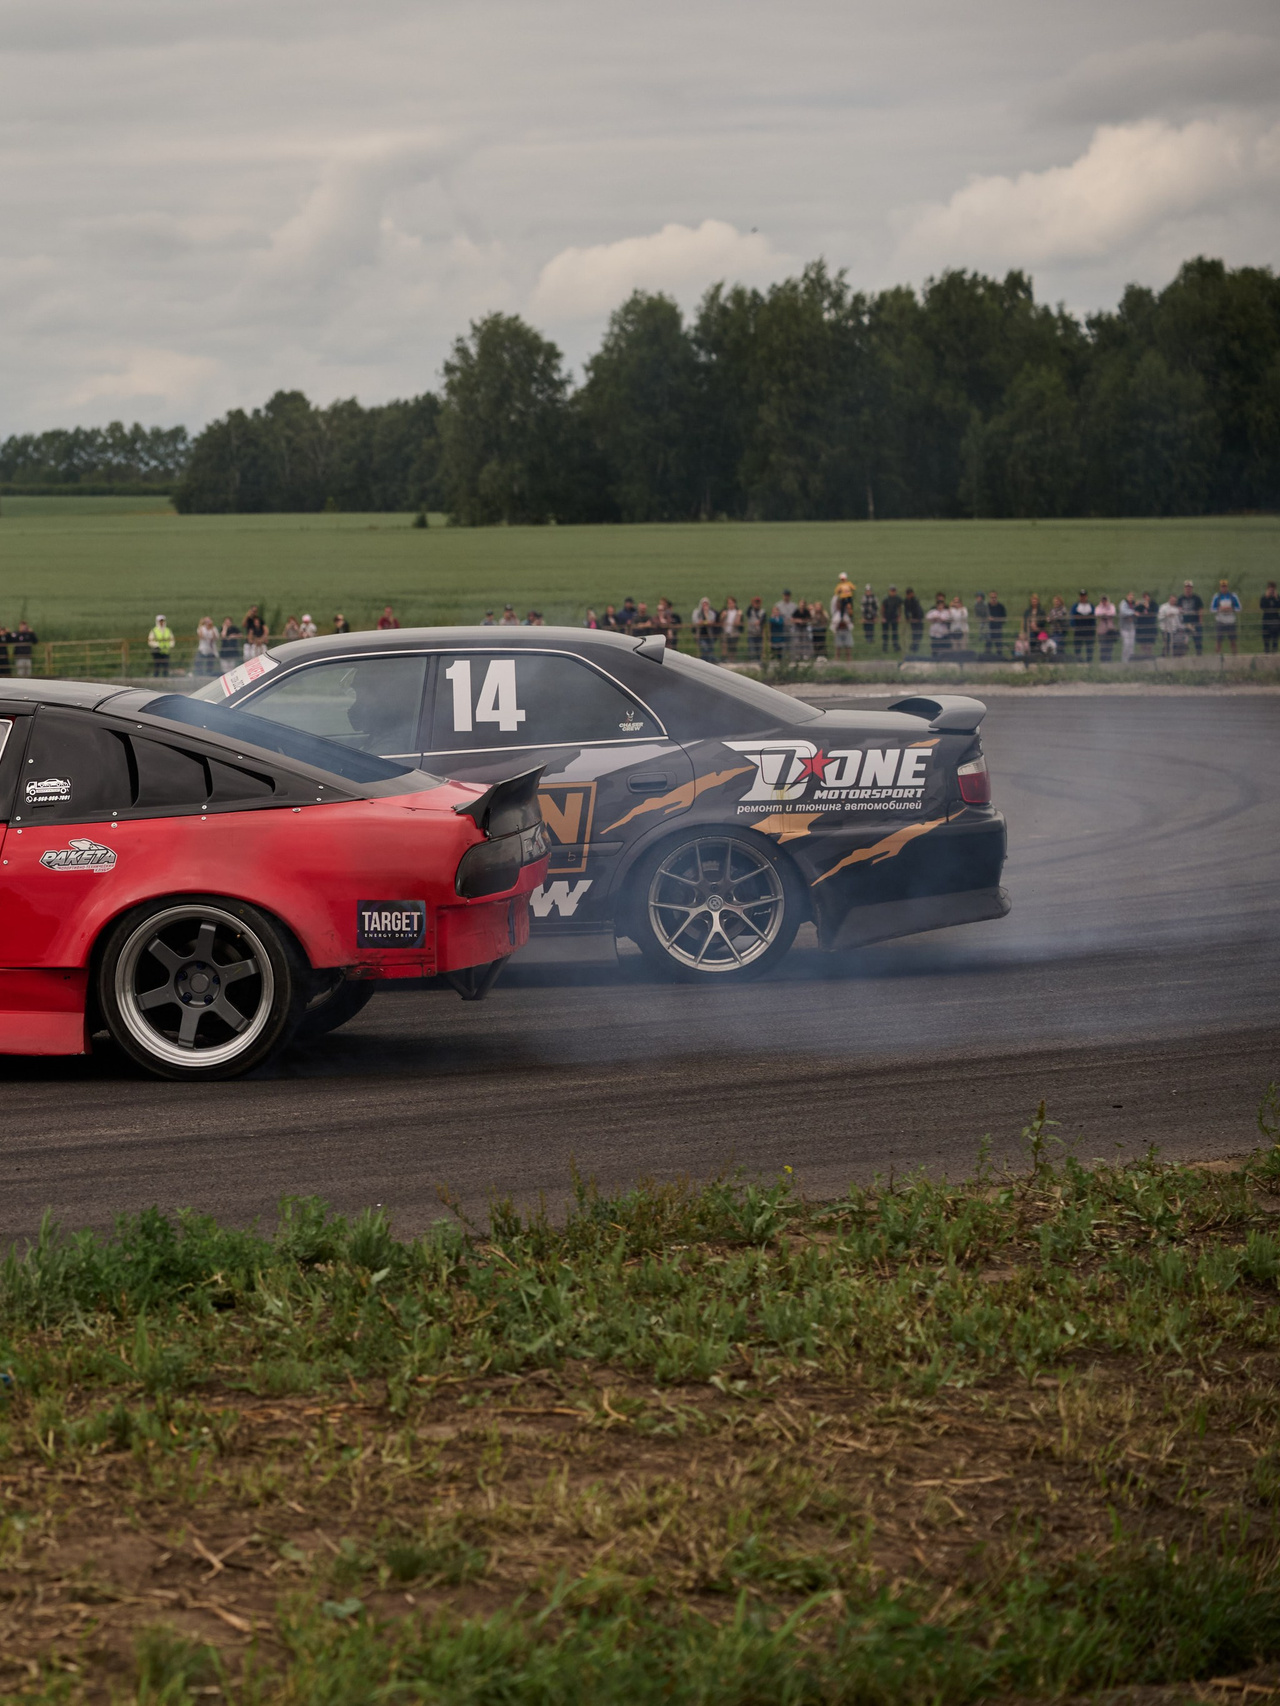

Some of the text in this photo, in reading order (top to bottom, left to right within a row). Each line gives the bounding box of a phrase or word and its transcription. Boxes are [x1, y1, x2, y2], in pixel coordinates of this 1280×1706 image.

[445, 660, 526, 732] 14
[814, 788, 925, 800] MOTORSPORT
[737, 799, 923, 814] ремонт и тюнинг автомобилей
[362, 911, 421, 931] TARGET
